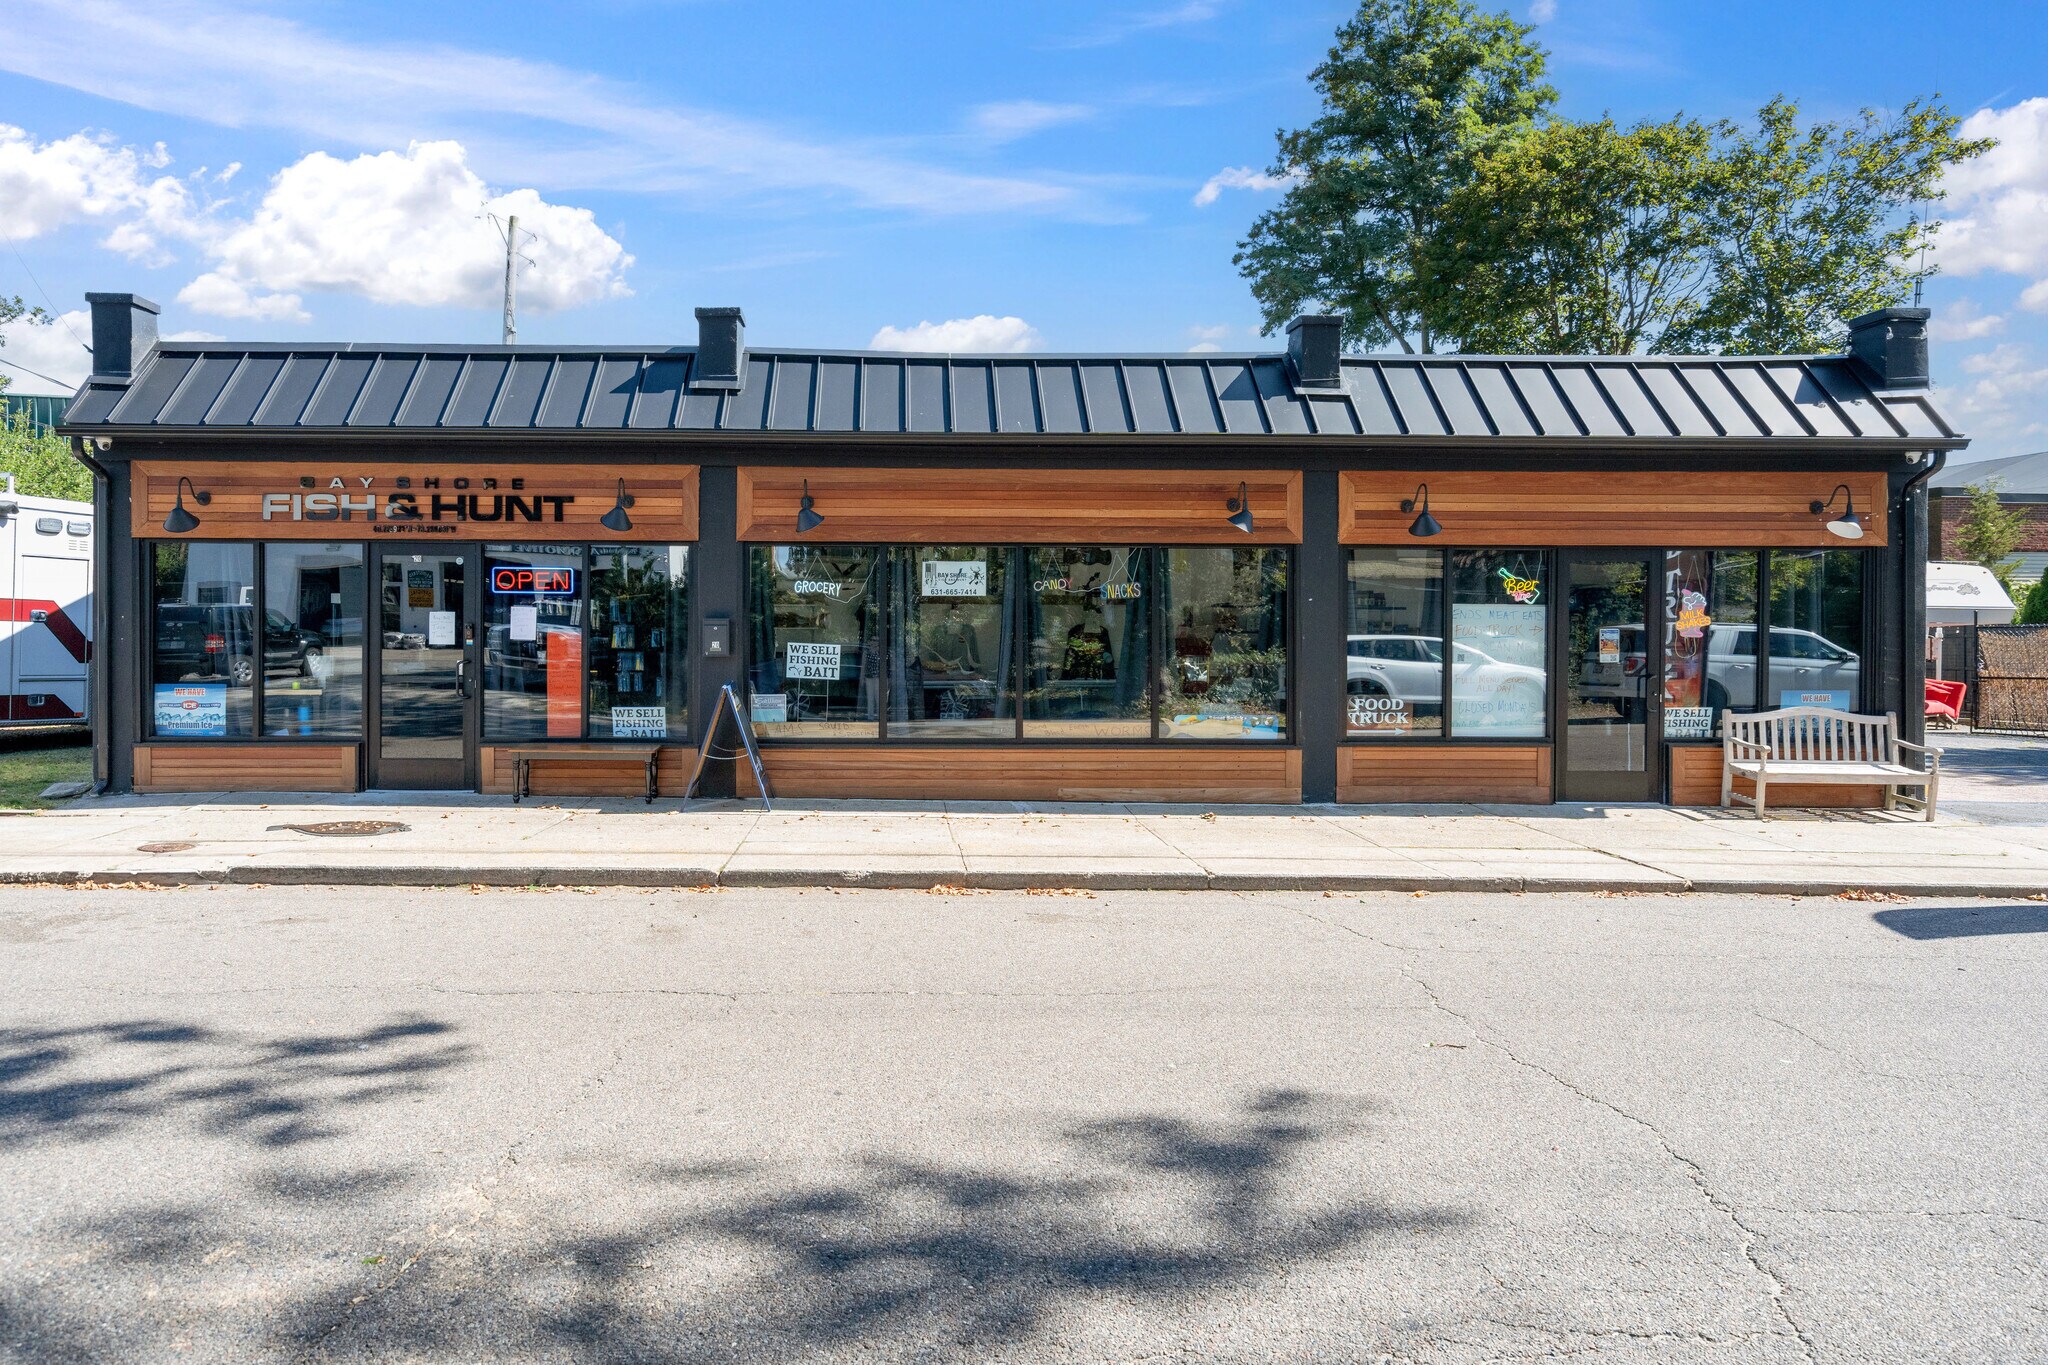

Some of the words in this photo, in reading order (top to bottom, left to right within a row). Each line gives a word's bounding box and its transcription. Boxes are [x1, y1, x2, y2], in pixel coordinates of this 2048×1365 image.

[300, 477, 375, 489] BAY
[396, 477, 525, 490] SHORE
[262, 493, 376, 521] FISH
[385, 493, 424, 521] &
[430, 494, 575, 522] HUNT
[496, 570, 569, 590] OPEN
[1033, 578, 1073, 592] CANDY
[794, 580, 842, 597] GROCERY
[930, 588, 977, 596] 631-665-7414
[1100, 582, 1141, 599] SNACKS
[1503, 578, 1540, 595] Beer
[1453, 608, 1481, 620] ENDS
[1489, 610, 1518, 620] MEAT
[1522, 610, 1544, 620] EATS
[1680, 609, 1704, 620] MILK
[1676, 616, 1710, 630] SHAKES
[1487, 624, 1522, 636] TRUCK
[789, 644, 809, 654] WE
[811, 645, 839, 655] SELL
[789, 655, 837, 666] FISHING
[804, 666, 838, 678] BAIT
[175, 688, 186, 696] WE
[187, 688, 205, 696] HAVE
[1476, 685, 1493, 693] ALL
[1354, 698, 1404, 710] FOOD
[1802, 694, 1813, 702] WE
[1814, 694, 1831, 702] HAVE
[614, 708, 633, 718] WE
[636, 708, 664, 718] SELL
[1459, 700, 1493, 714] CLOSED
[1348, 712, 1409, 724] TRUCK
[1683, 709, 1710, 718] SELL
[167, 721, 200, 729] Premium
[615, 719, 663, 728] FISHING
[754, 723, 804, 736] CLAMS
[818, 722, 850, 731] SQUID
[630, 729, 665, 738] BAIT
[1094, 724, 1151, 737] WORMS
